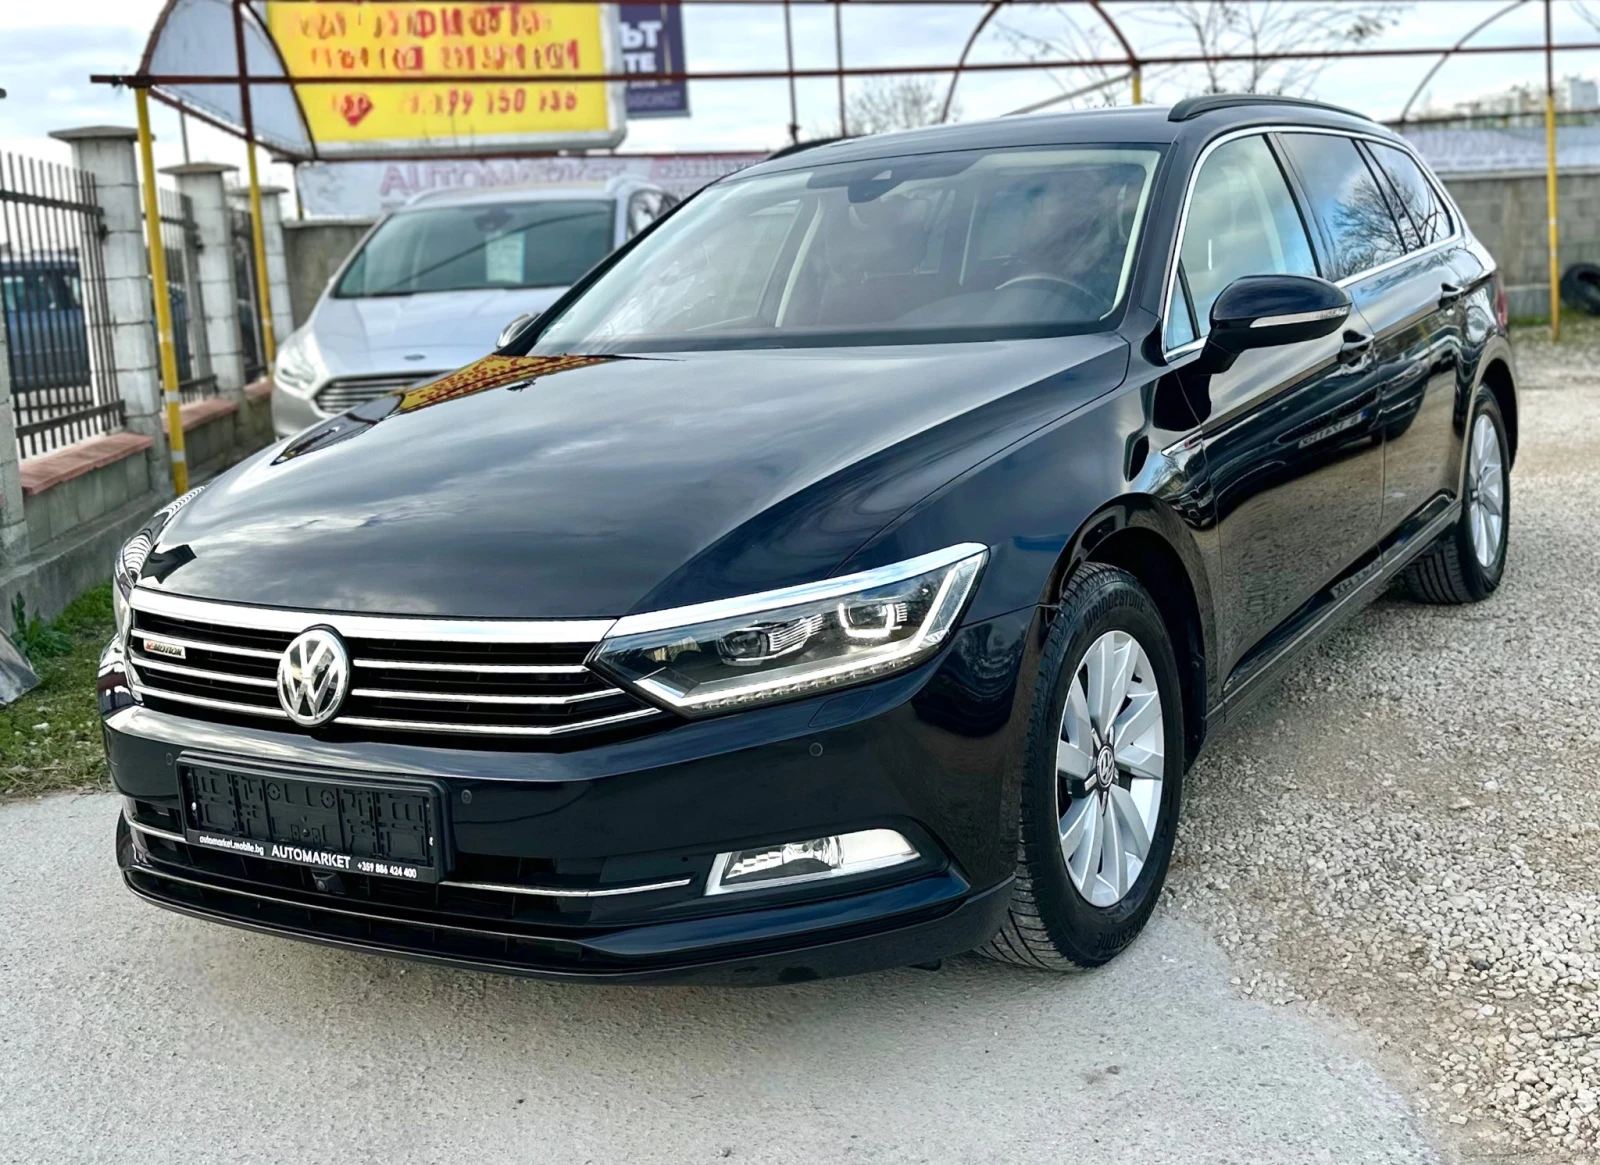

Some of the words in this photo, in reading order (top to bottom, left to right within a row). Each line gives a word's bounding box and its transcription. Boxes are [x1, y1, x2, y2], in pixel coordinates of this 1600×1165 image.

[199, 835, 264, 856] automarket.mobile.bg
[272, 845, 351, 869] AUTOMARKET
[357, 861, 374, 873] +359
[389, 865, 403, 877] 424
[403, 866, 417, 878] 400
